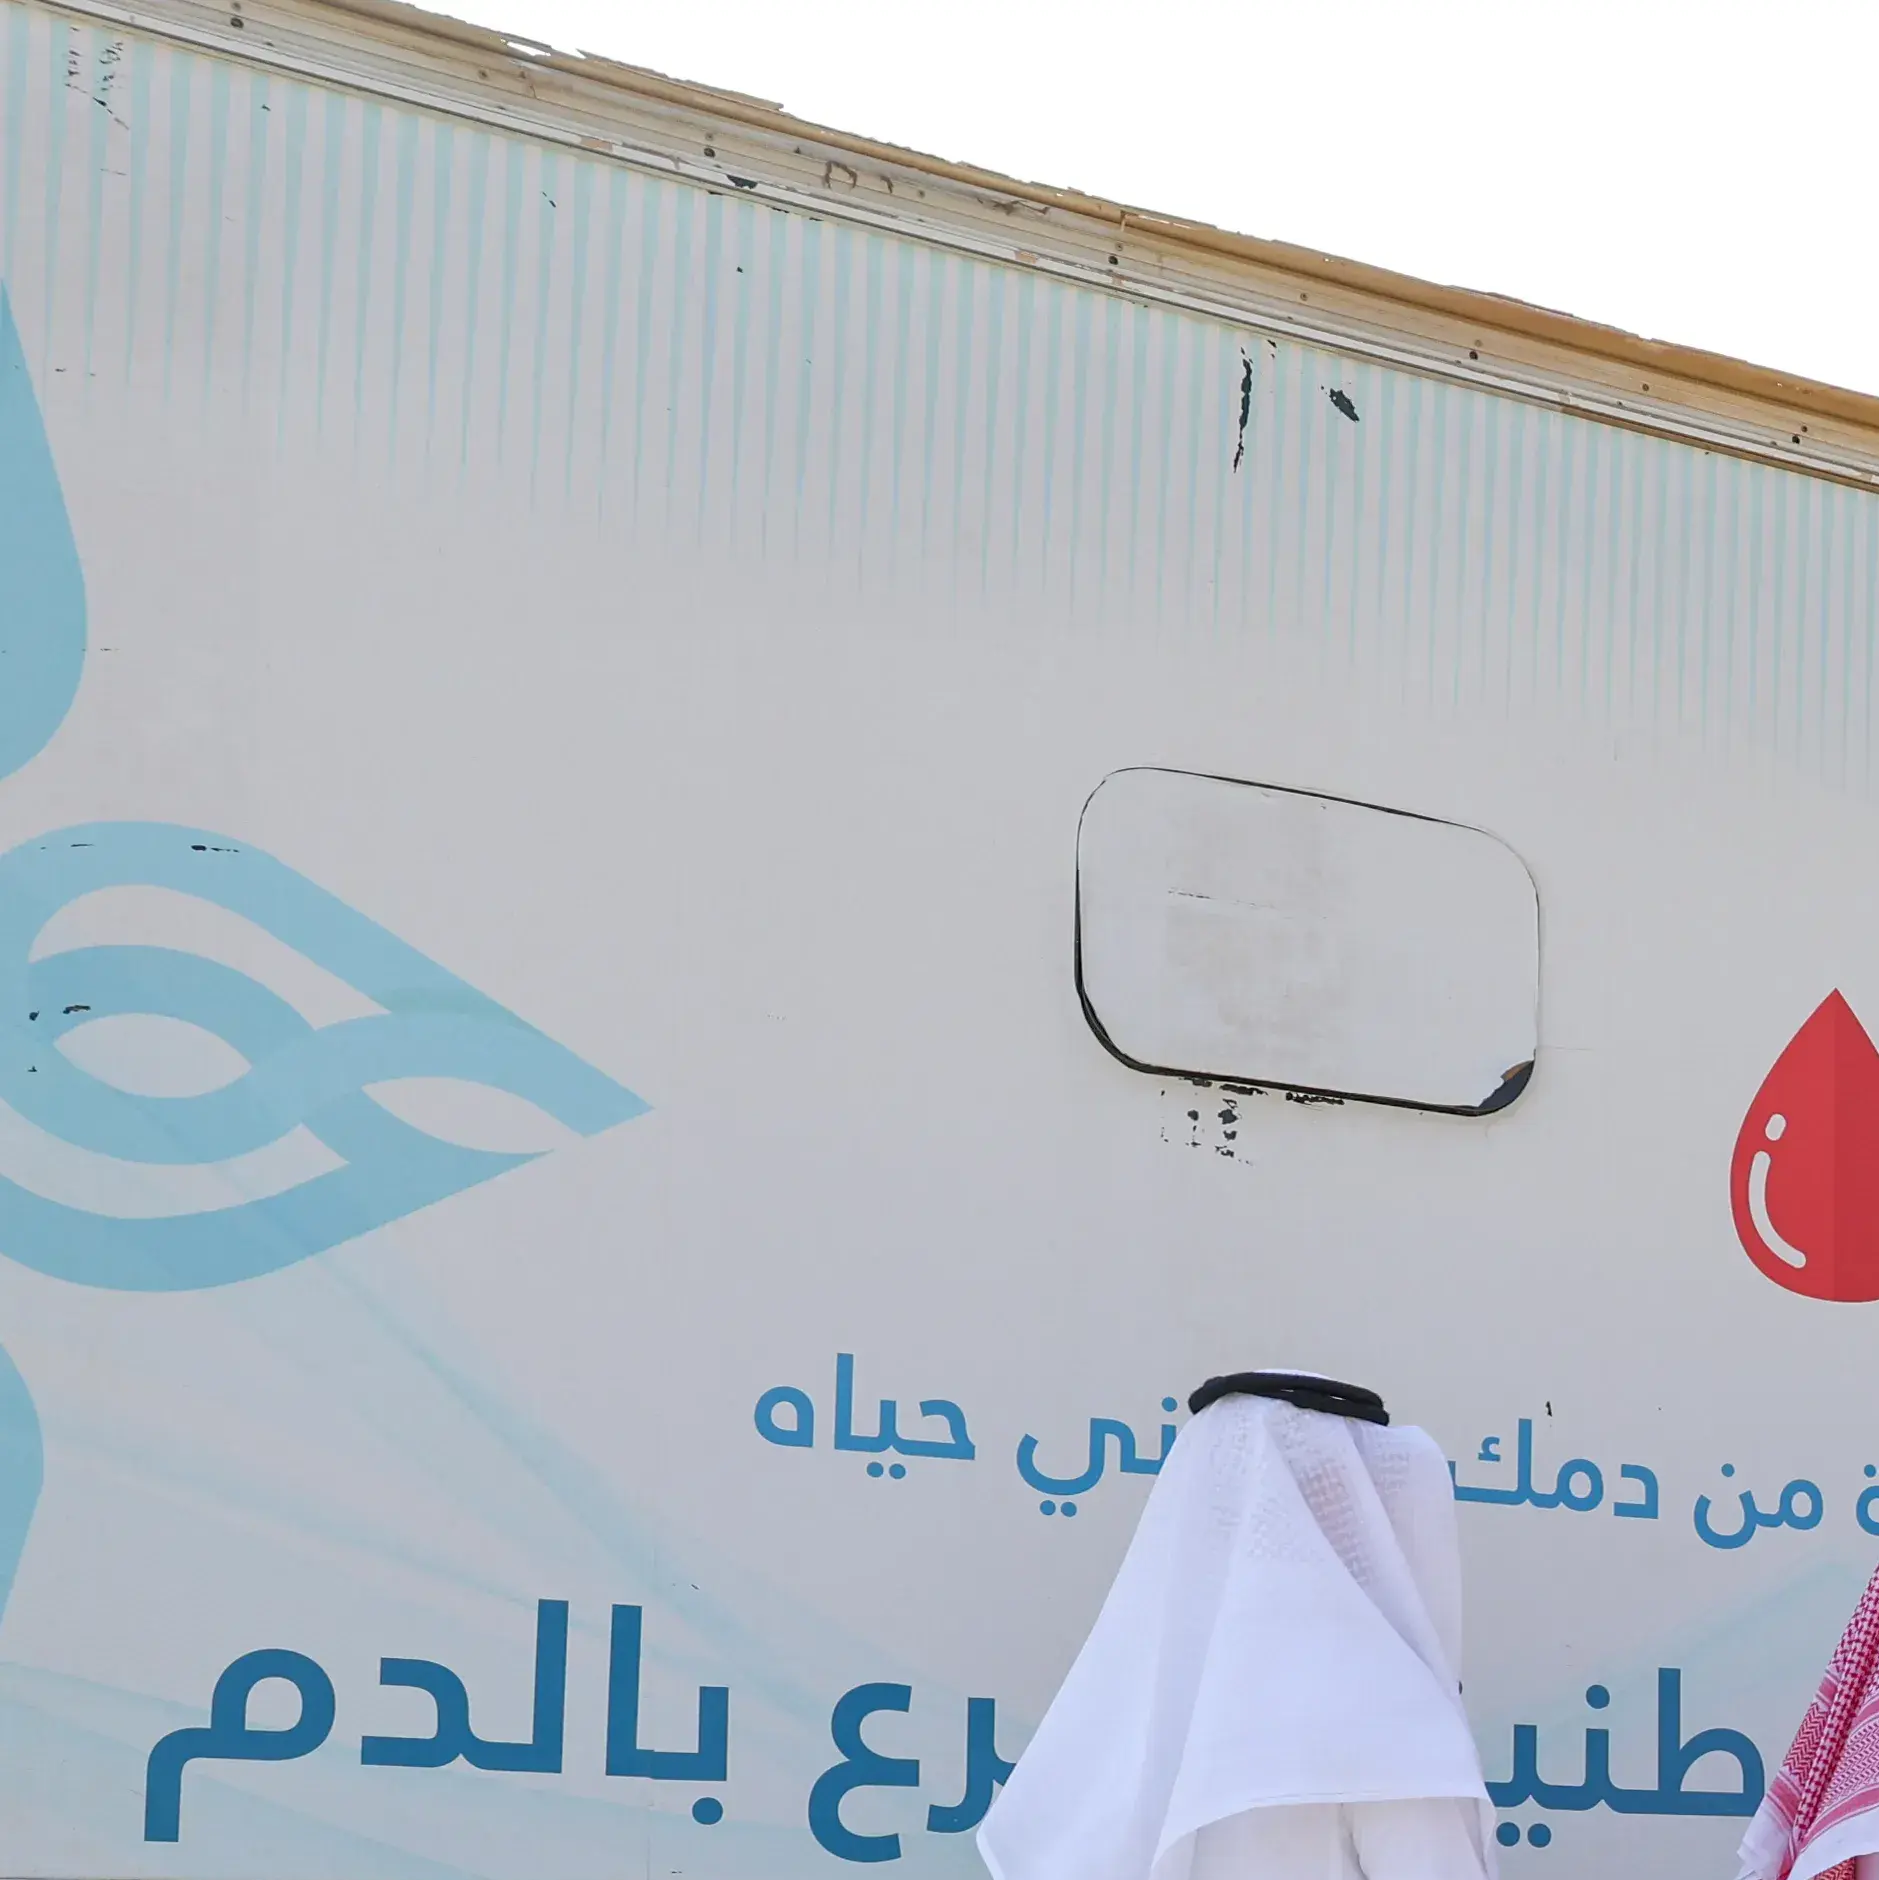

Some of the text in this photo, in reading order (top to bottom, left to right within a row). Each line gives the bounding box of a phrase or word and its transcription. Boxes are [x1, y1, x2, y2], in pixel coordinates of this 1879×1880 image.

[753, 1352, 976, 1480] حياه
[1447, 1417, 1660, 1521] دمك
[1693, 1462, 1824, 1550] من
[143, 1598, 730, 1843] بالدم
